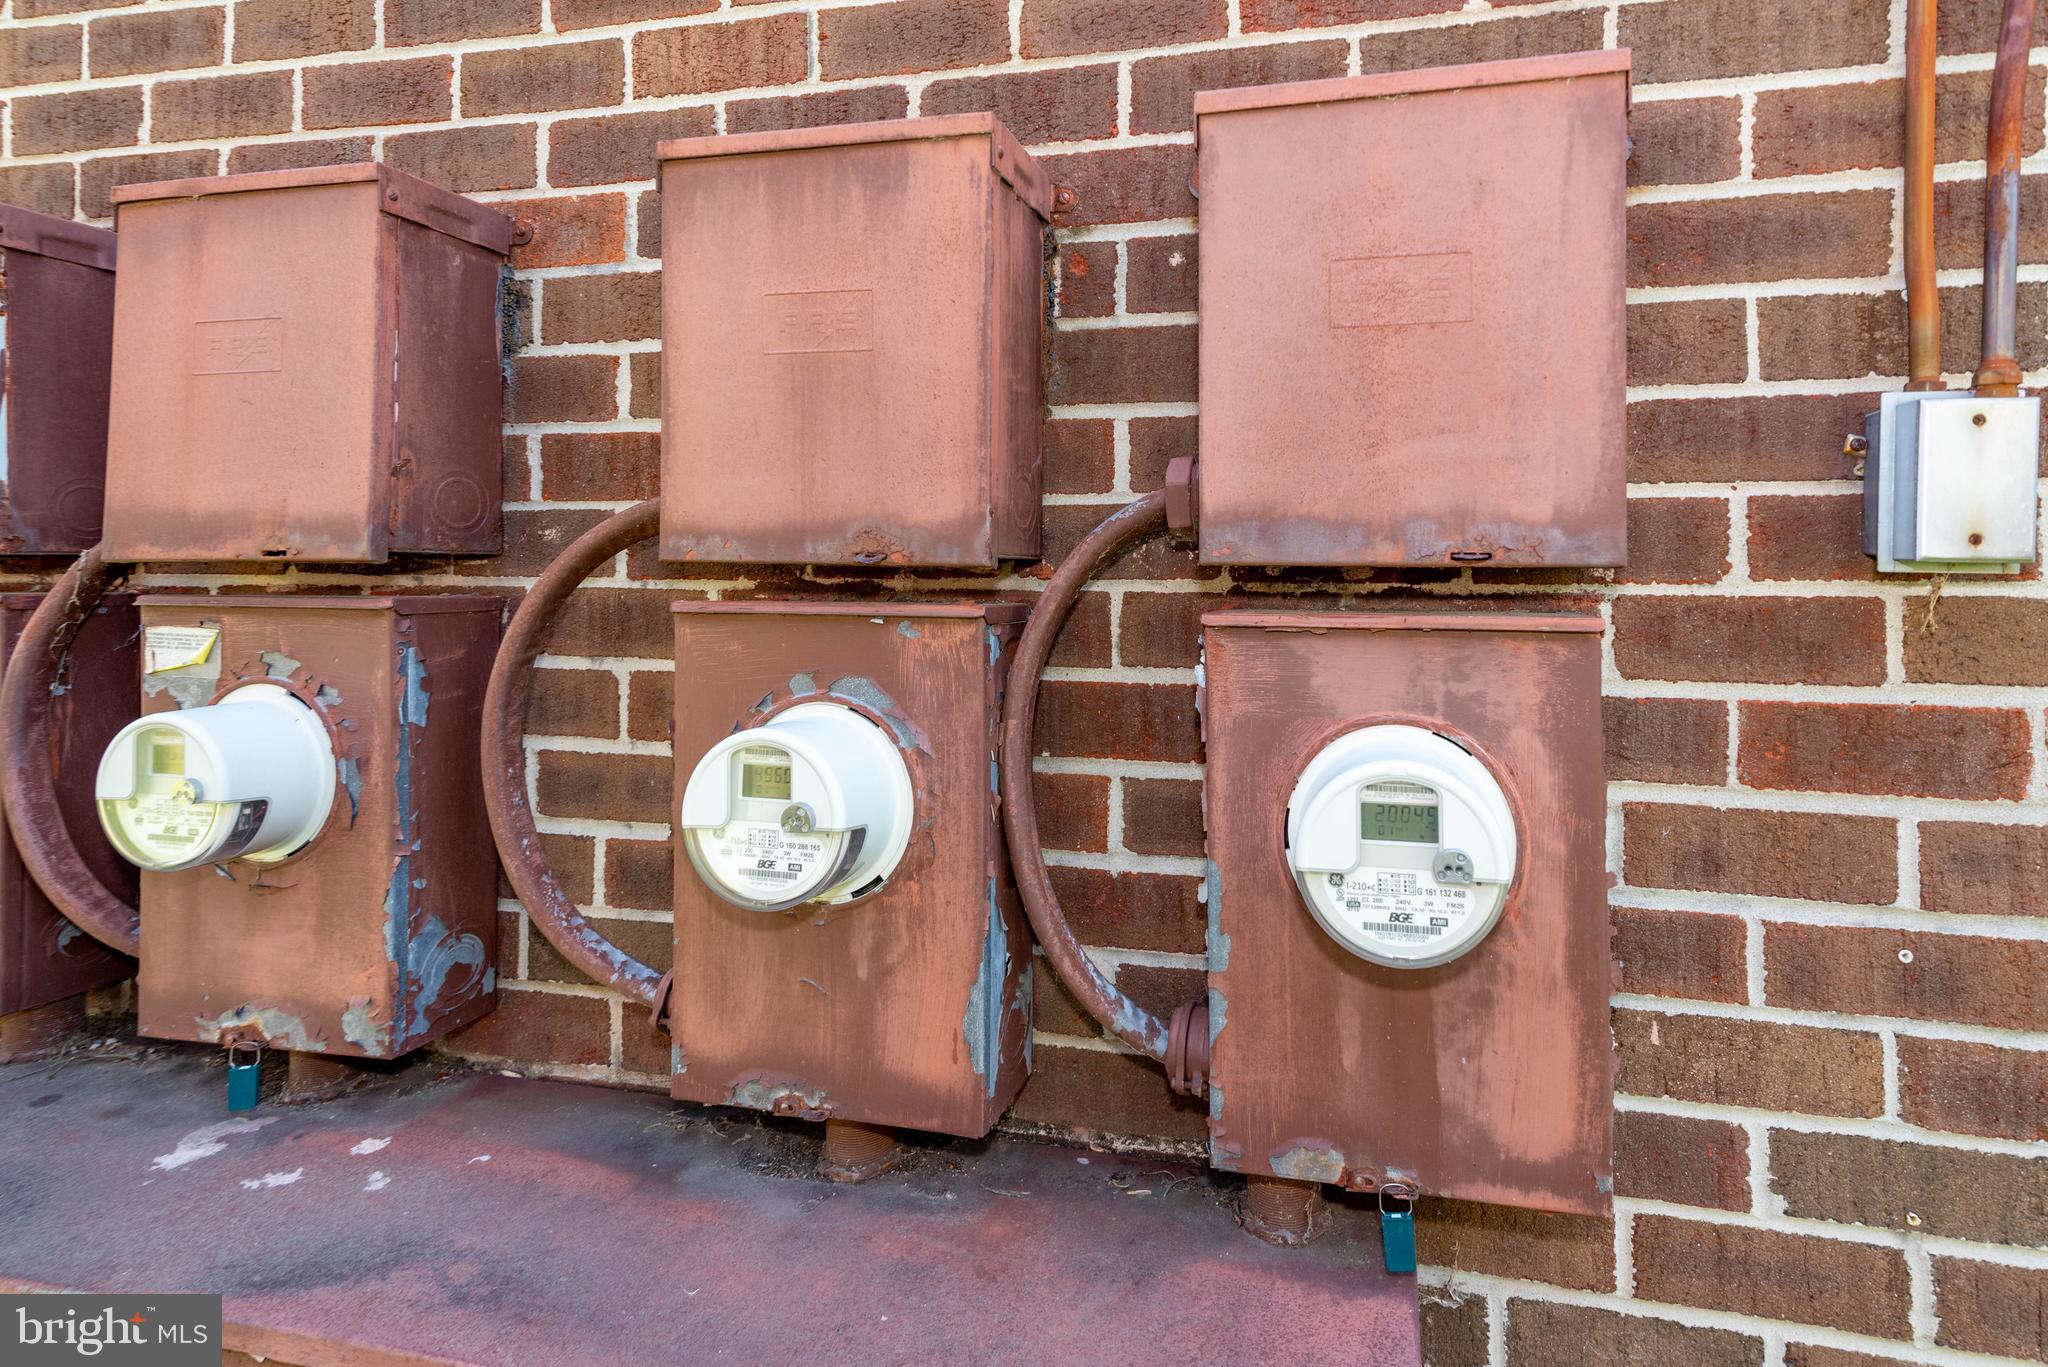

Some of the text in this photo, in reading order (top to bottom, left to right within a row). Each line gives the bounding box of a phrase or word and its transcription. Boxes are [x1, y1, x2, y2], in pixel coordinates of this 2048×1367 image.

[757, 859, 777, 870] BGE
[1416, 887, 1424, 896] G
[1425, 888, 1437, 897] 161
[1439, 889, 1452, 898] 132
[1389, 911, 1414, 924] BGE
